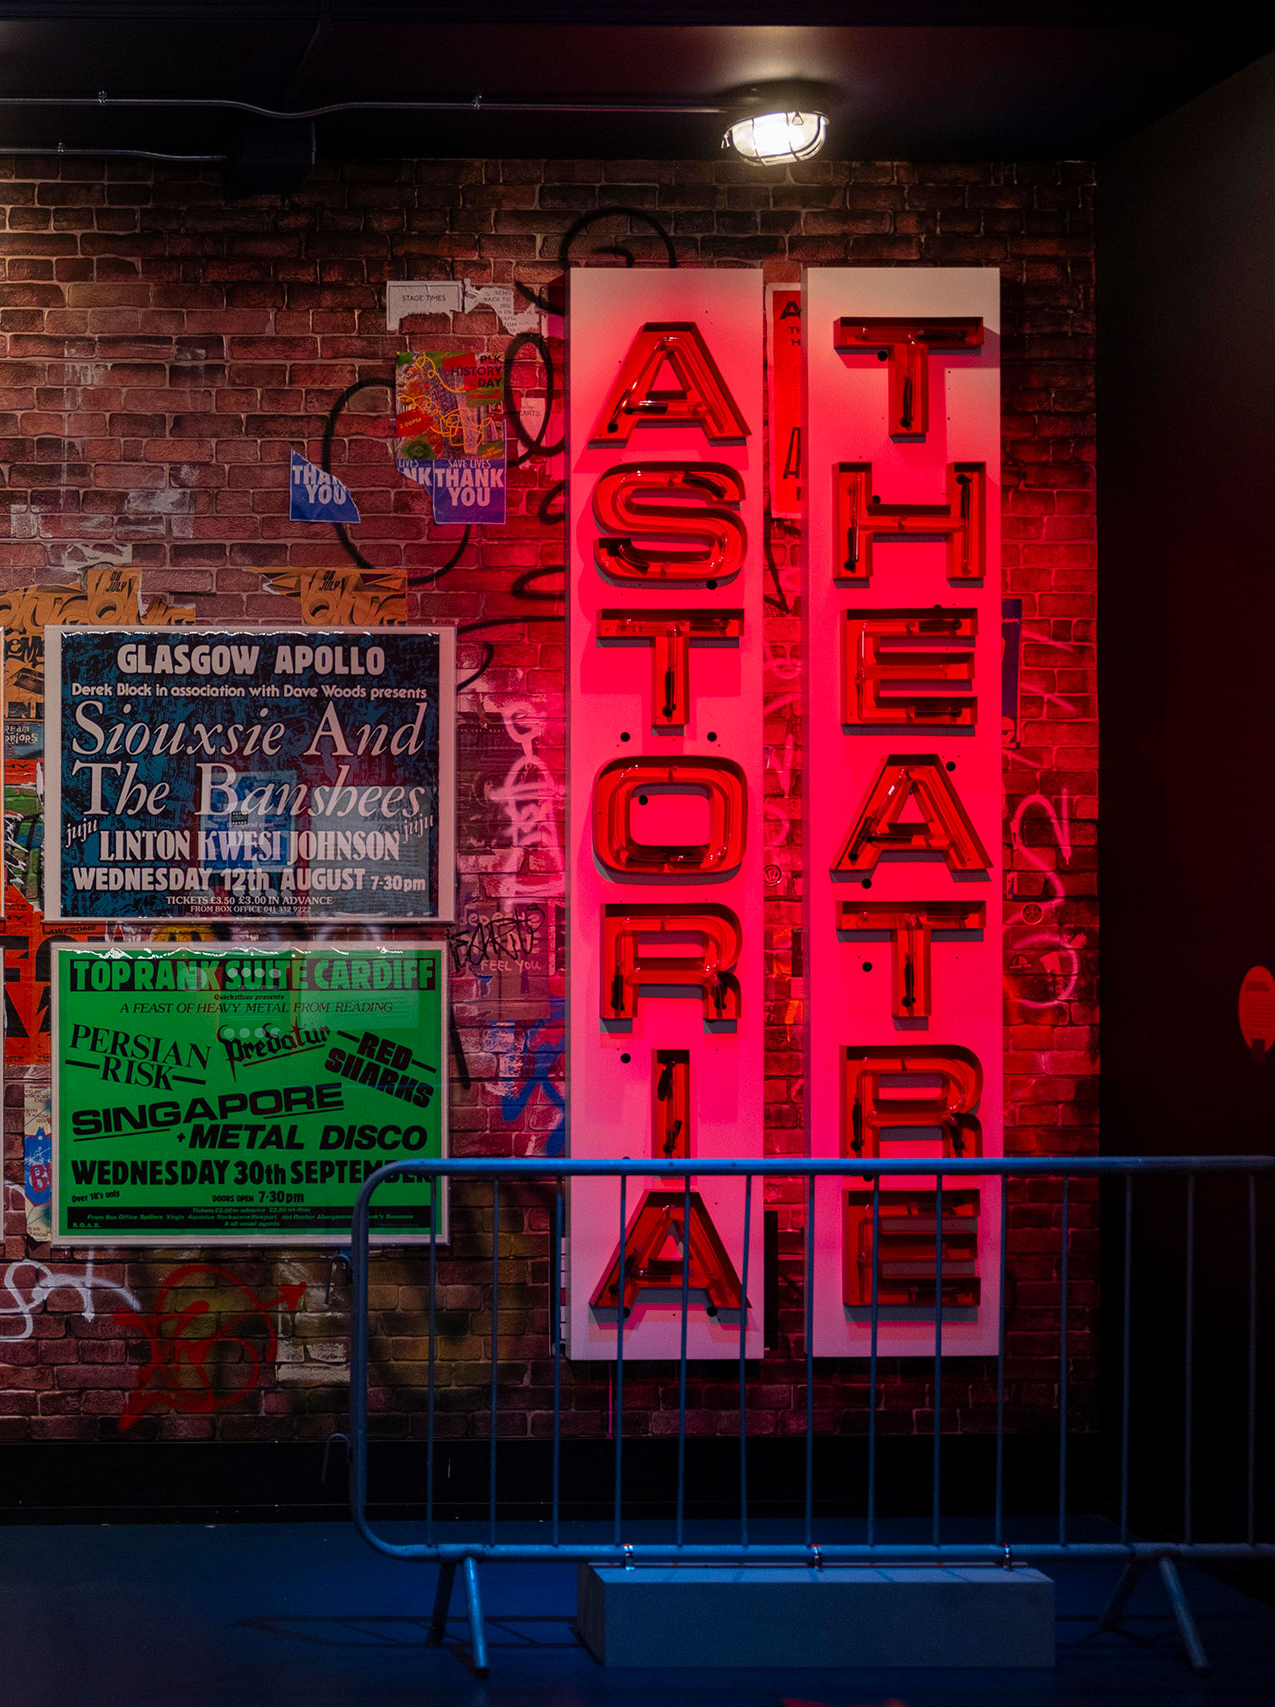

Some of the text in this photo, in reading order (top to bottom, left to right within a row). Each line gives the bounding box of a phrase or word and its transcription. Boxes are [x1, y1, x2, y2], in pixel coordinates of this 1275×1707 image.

[451, 367, 502, 376] HISTORY
[478, 378, 502, 387] DAY
[448, 459, 491, 468] SAVE LIVES
[435, 468, 503, 487] THANK
[305, 484, 347, 505] YOU
[448, 488, 490, 506] YOU
[106, 581, 127, 592] JULY
[319, 580, 341, 590] JULY
[118, 644, 386, 676] GLASGOW APOLLO
[72, 683, 427, 701] Derek Block in association with Dave Woods presents
[72, 700, 427, 756] Siouxsie And
[72, 762, 425, 818] The Banshees
[589, 321, 753, 1315] ASTORIA
[830, 316, 994, 1312] THEATRE
[64, 817, 99, 848] juju
[100, 830, 401, 864] LINTON KWESI JOHNSON
[72, 867, 212, 891] WEDNESDAY
[220, 868, 269, 891] 12th
[281, 868, 365, 891] AUGUST
[166, 896, 333, 905] TICKETS £3.50 £3.00 IN ADVANCE
[190, 905, 213, 913] FROM
[215, 905, 232, 913] BOX
[234, 905, 261, 913] OFFICE
[264, 905, 277, 913] 041
[73, 960, 435, 991] TOP RANK SUITE CARDIFF
[120, 1002, 393, 1013] A FEAST OF HEAVY METAL FROM READING
[70, 1023, 212, 1071] PERSIAN
[358, 1032, 414, 1071] RED
[101, 1056, 175, 1091] RISK
[324, 1047, 435, 1109] SHARKS
[72, 1083, 344, 1136] SINGAPORE
[189, 1124, 427, 1151] METAL DISCO
[71, 1160, 230, 1186] WEDNESDAY
[234, 1160, 286, 1186] 30th
[72, 1189, 120, 1203] Over only
[212, 1194, 232, 1203] DOORS
[235, 1195, 254, 1203] OPEN
